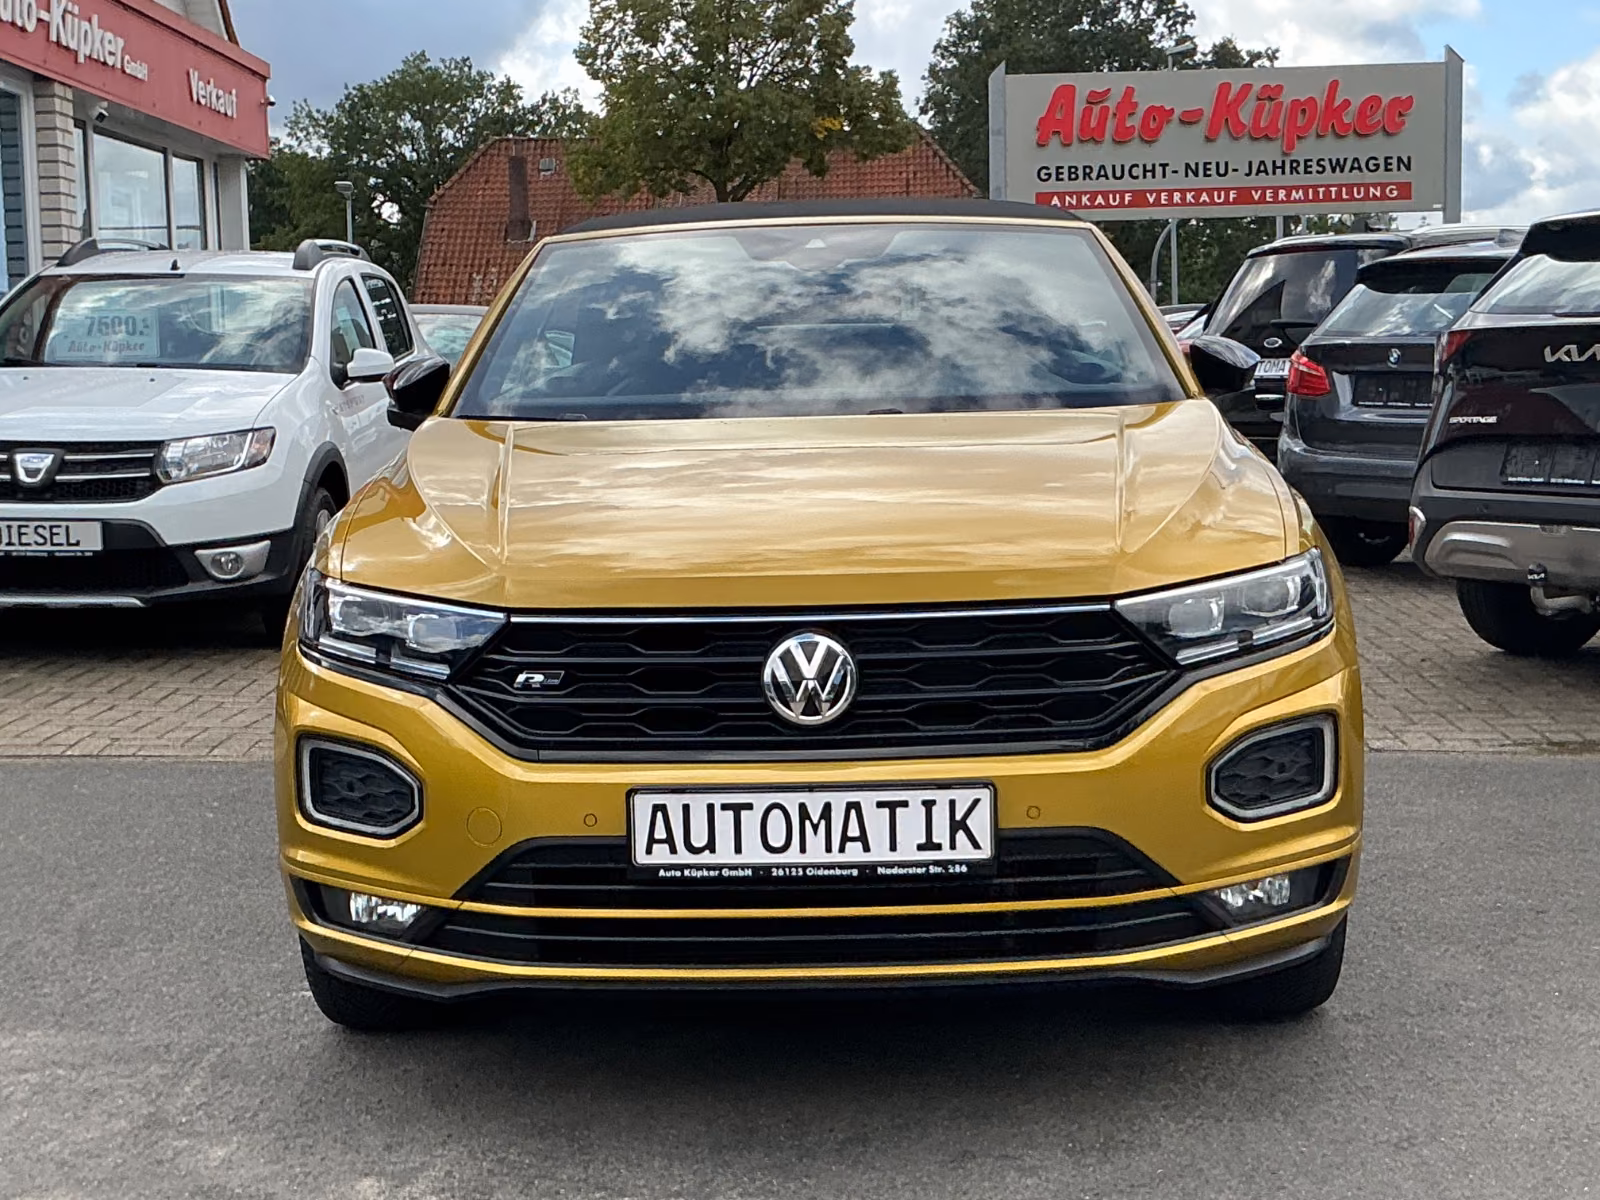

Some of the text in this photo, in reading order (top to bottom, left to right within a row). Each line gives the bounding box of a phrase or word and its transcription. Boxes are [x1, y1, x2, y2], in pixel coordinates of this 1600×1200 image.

[189, 67, 237, 119] Verkauf
[1050, 185, 1399, 208] ANKAUF VERKAUF VERMITTLUNG
[1257, 360, 1287, 374] TOMA
[0, 524, 81, 547] IESEL
[645, 798, 983, 855] AUTOMATIK
[658, 868, 682, 877] Auto
[683, 868, 719, 878] Küpker
[721, 868, 752, 877] GmbH
[805, 866, 858, 877] Oldenburg
[928, 864, 945, 874] Str.
[947, 864, 968, 873] 286
